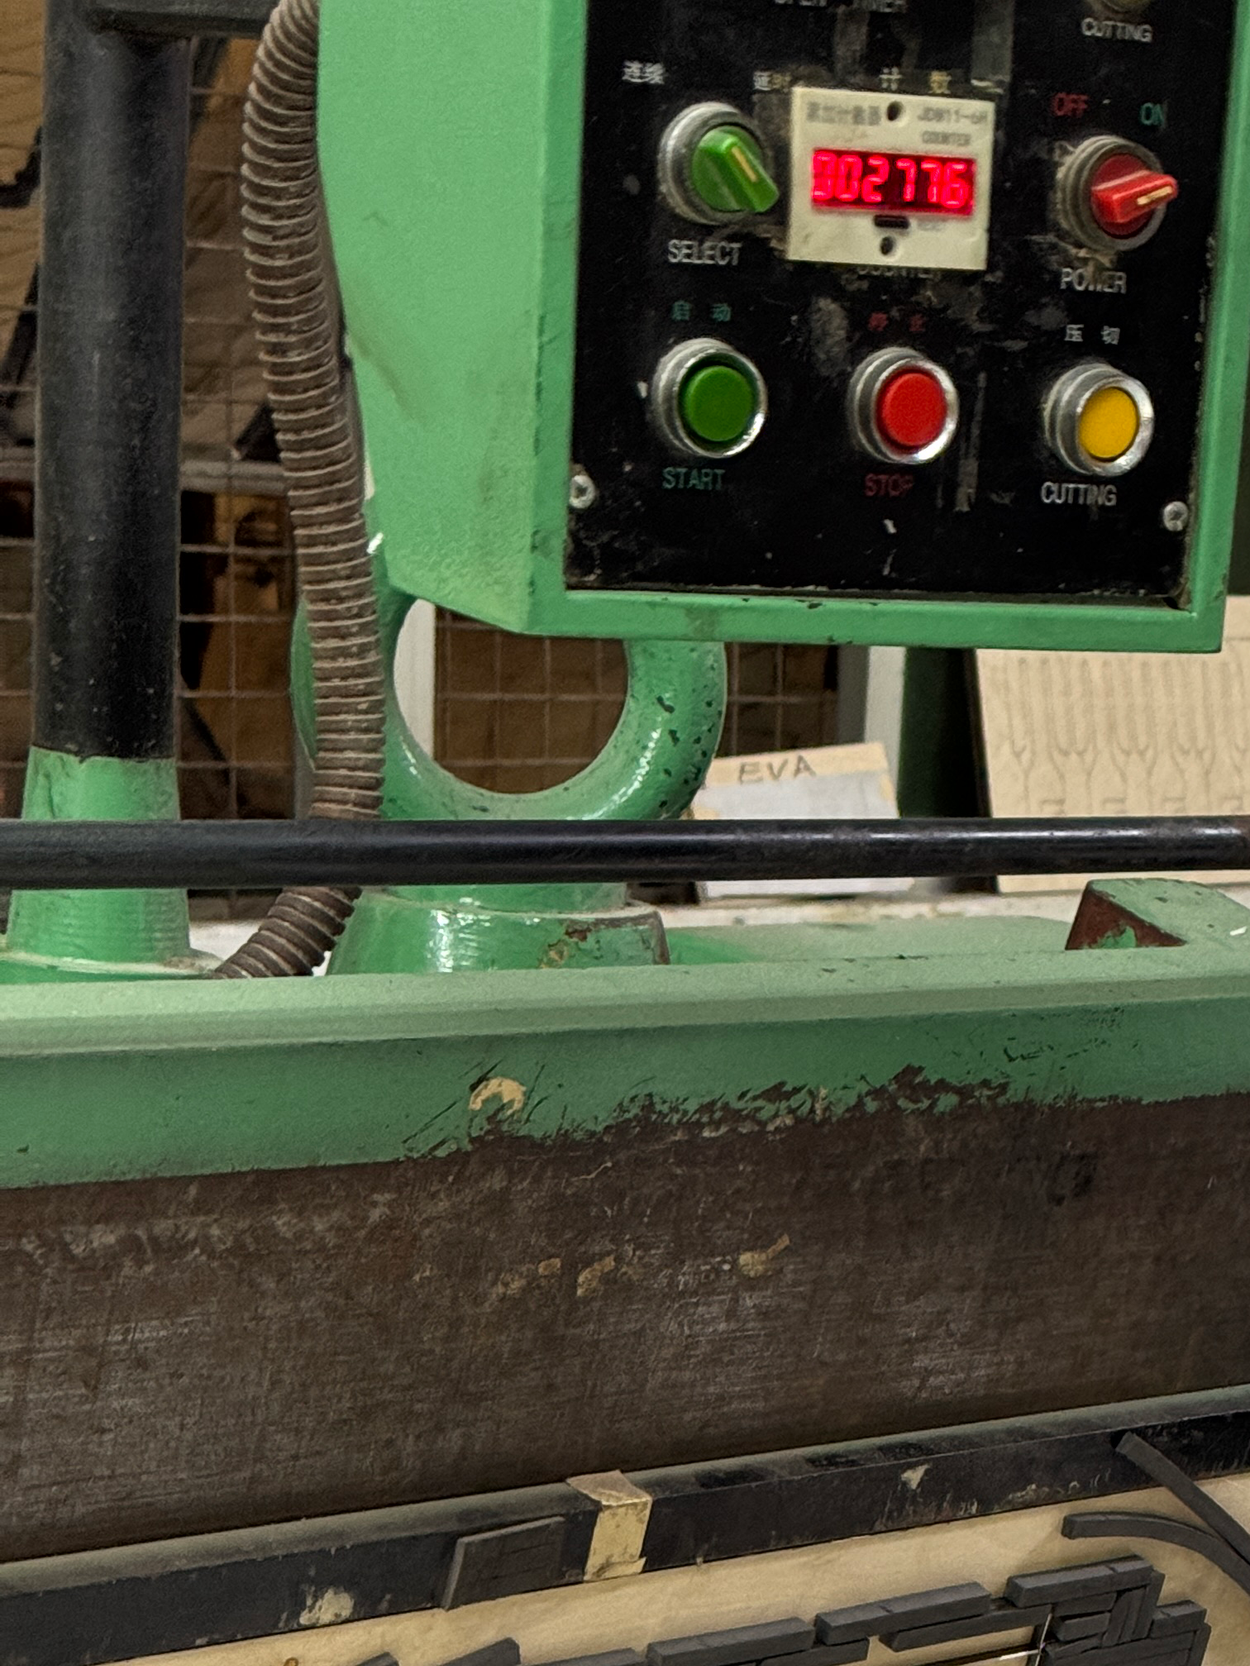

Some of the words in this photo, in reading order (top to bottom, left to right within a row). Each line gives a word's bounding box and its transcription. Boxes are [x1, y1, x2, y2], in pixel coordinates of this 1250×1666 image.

[1081, 17, 1153, 43] CUTTING
[1053, 92, 1089, 117] OFF
[1140, 102, 1166, 127] ON
[667, 239, 743, 266] SELECT
[662, 467, 726, 491] START
[864, 472, 915, 498] STOP
[1040, 481, 1117, 507] CUTTING
[739, 755, 816, 784] EVA
